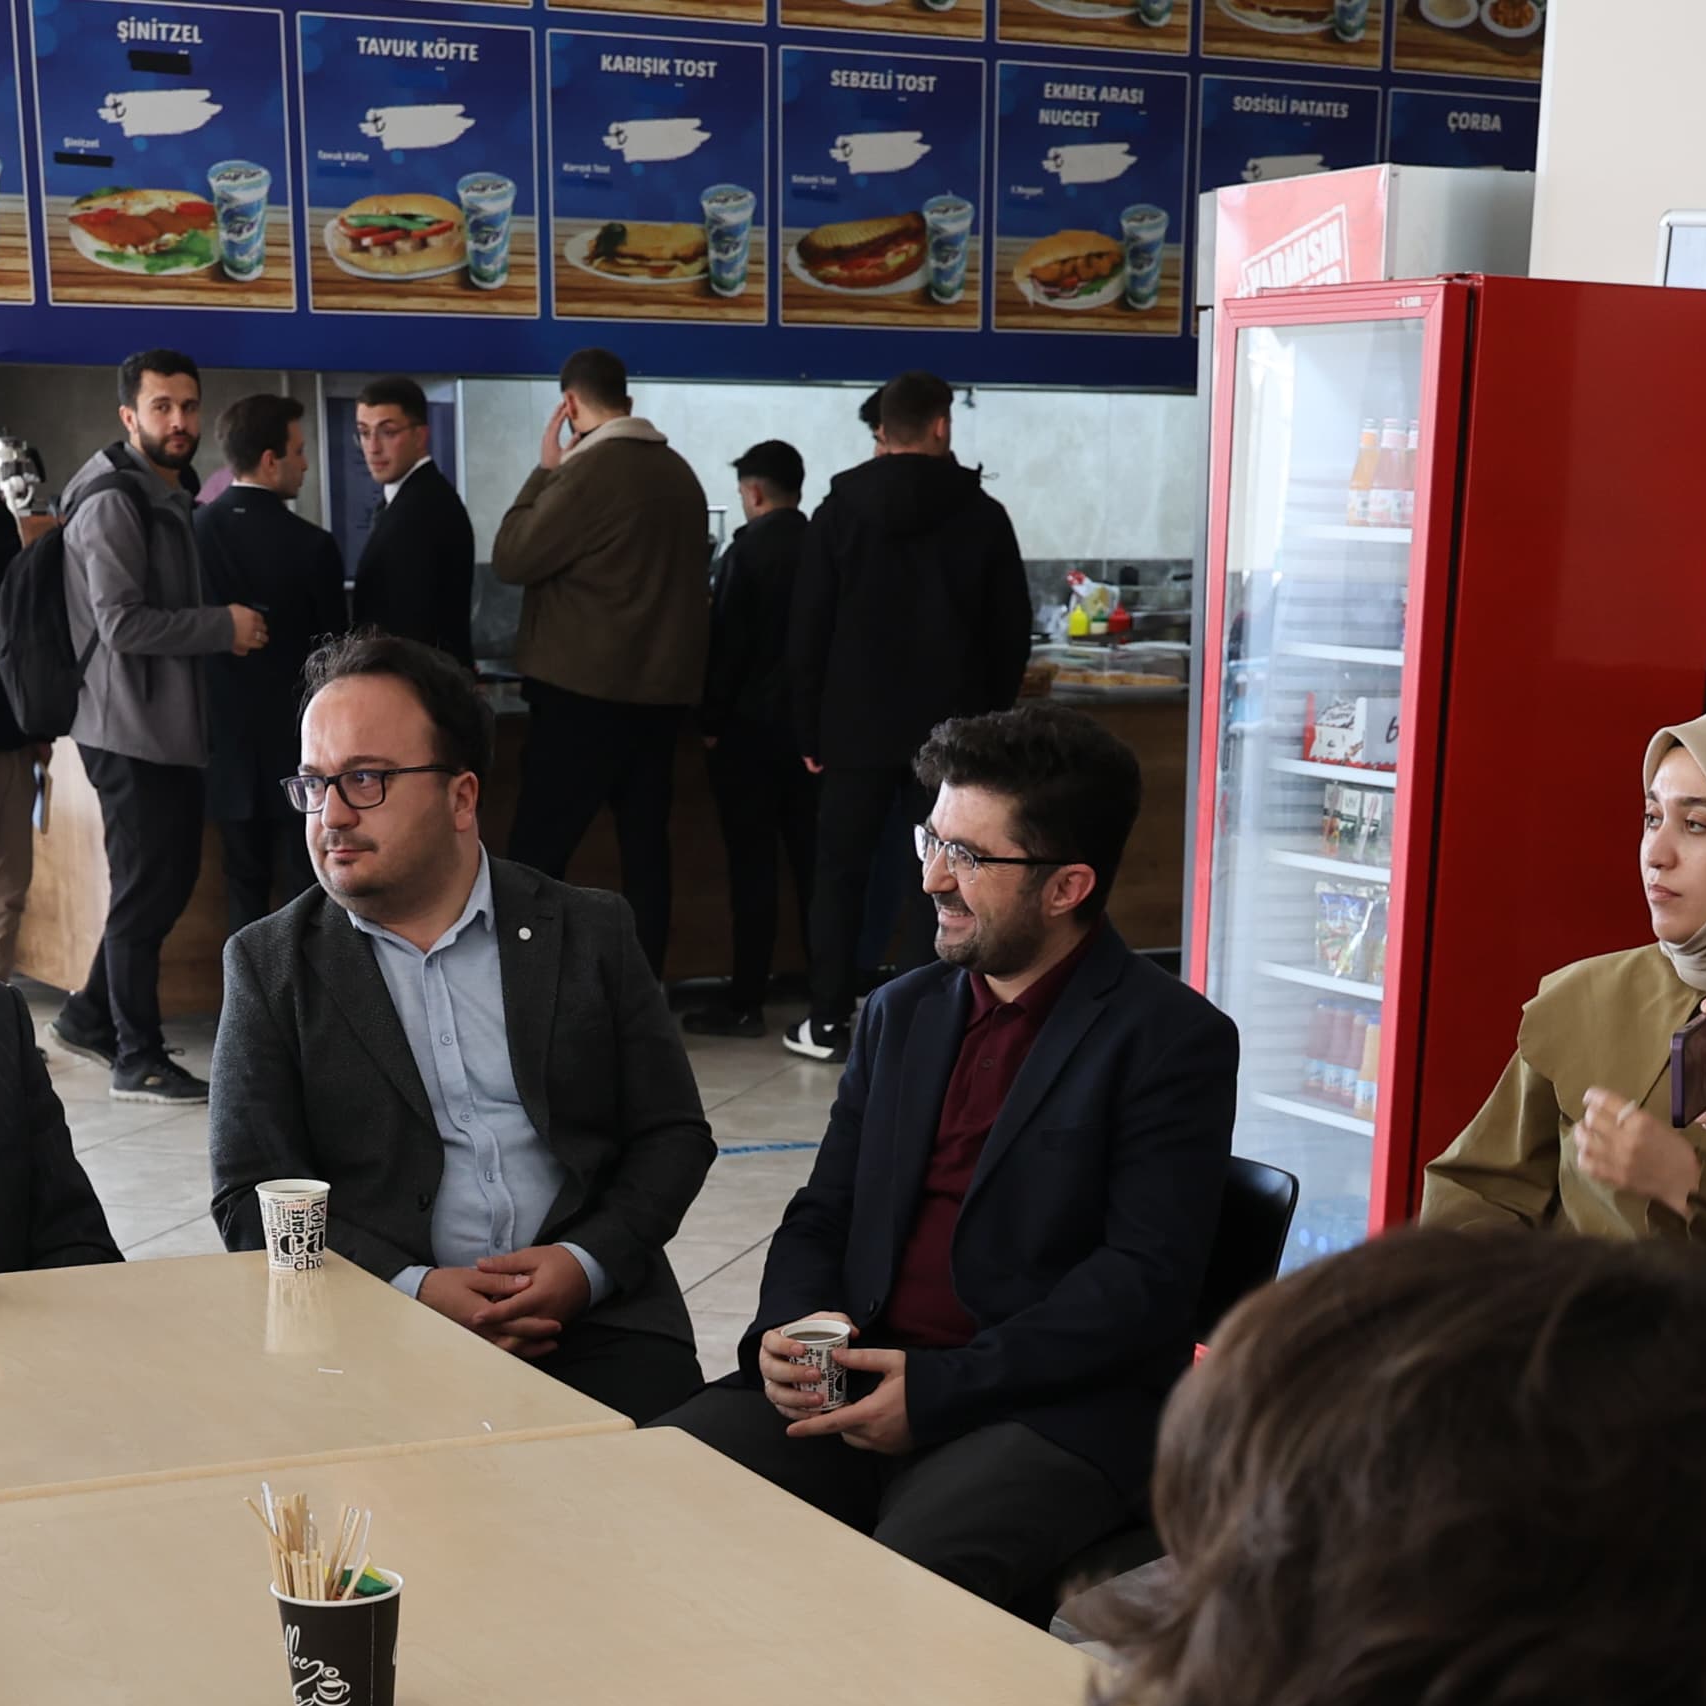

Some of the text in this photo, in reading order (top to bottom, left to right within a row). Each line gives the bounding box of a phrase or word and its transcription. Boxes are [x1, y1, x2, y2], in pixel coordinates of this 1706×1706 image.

[116, 16, 203, 43] ŞİNİTZEL
[357, 36, 479, 62] TAVUK KÖFTE
[600, 54, 718, 78] KARIŞIK TOST
[830, 68, 938, 92] SEBZELİ TOST
[1044, 82, 1145, 104] EKMEK ARASI
[1038, 108, 1101, 128] NUGGET
[1233, 94, 1349, 119] SOSİSLİ PATATES
[1447, 111, 1502, 134] ÇORBA
[292, 1209, 305, 1234] CAFE
